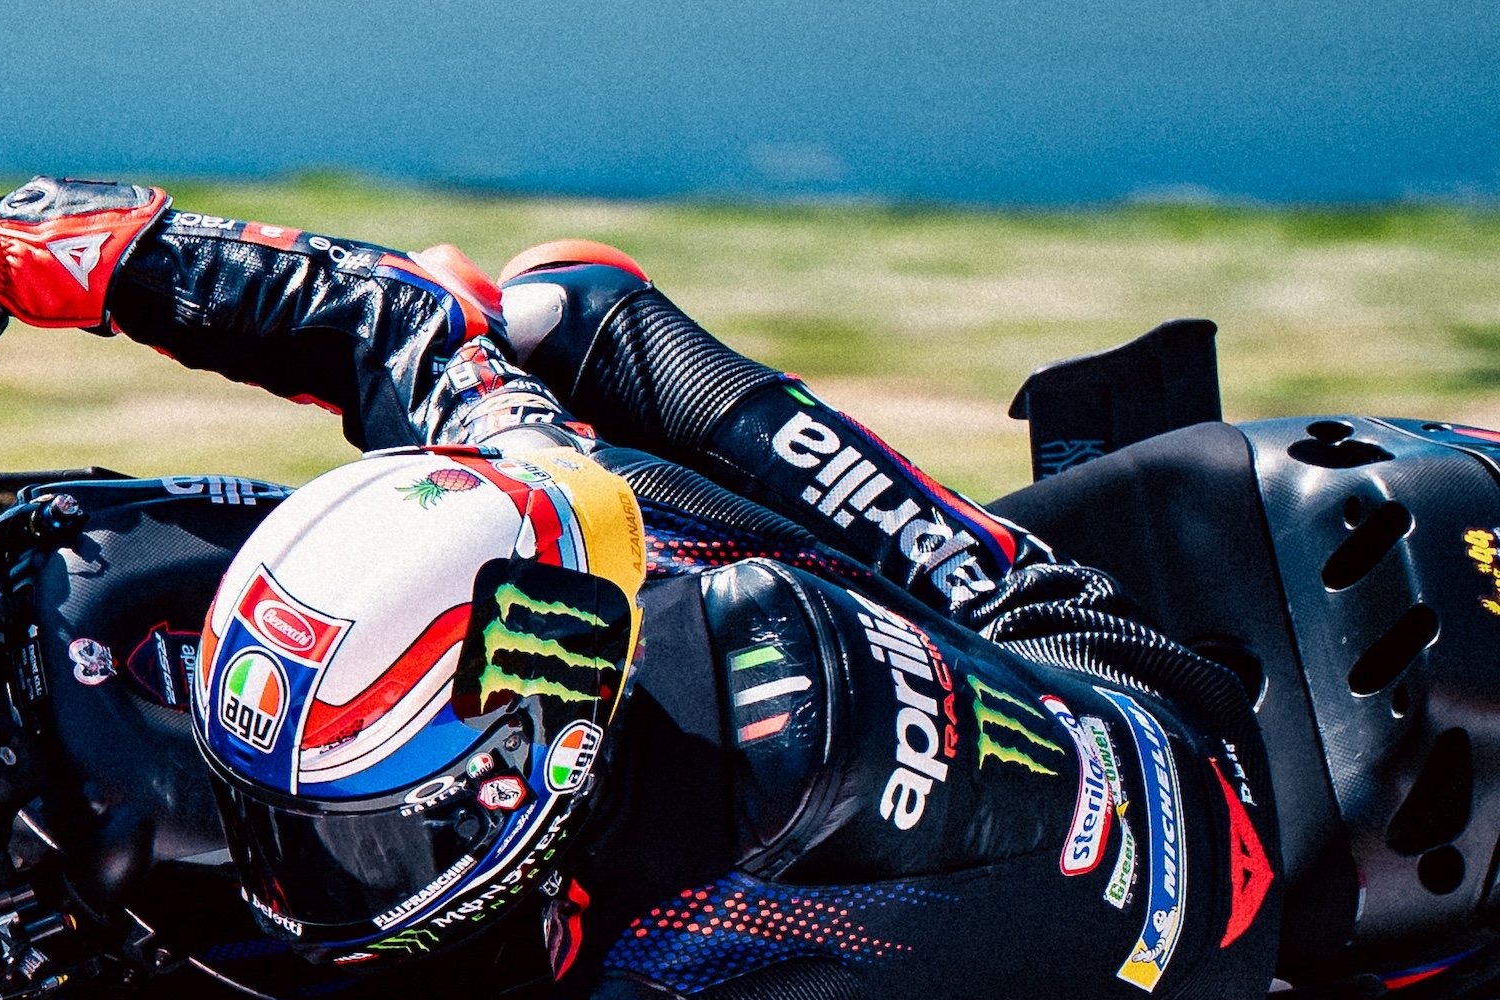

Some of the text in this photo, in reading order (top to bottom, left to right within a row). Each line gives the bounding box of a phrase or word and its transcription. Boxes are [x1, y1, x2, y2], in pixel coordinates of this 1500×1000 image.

[771, 410, 997, 609] aprilia
[262, 608, 313, 647] Bezzecchi
[224, 701, 274, 742] agv
[846, 588, 949, 831] aprilia
[568, 732, 598, 784] agv
[1127, 705, 1177, 900] MICHELIN
[401, 854, 475, 911] FRANCHINI
[432, 808, 573, 929] MONSTER
